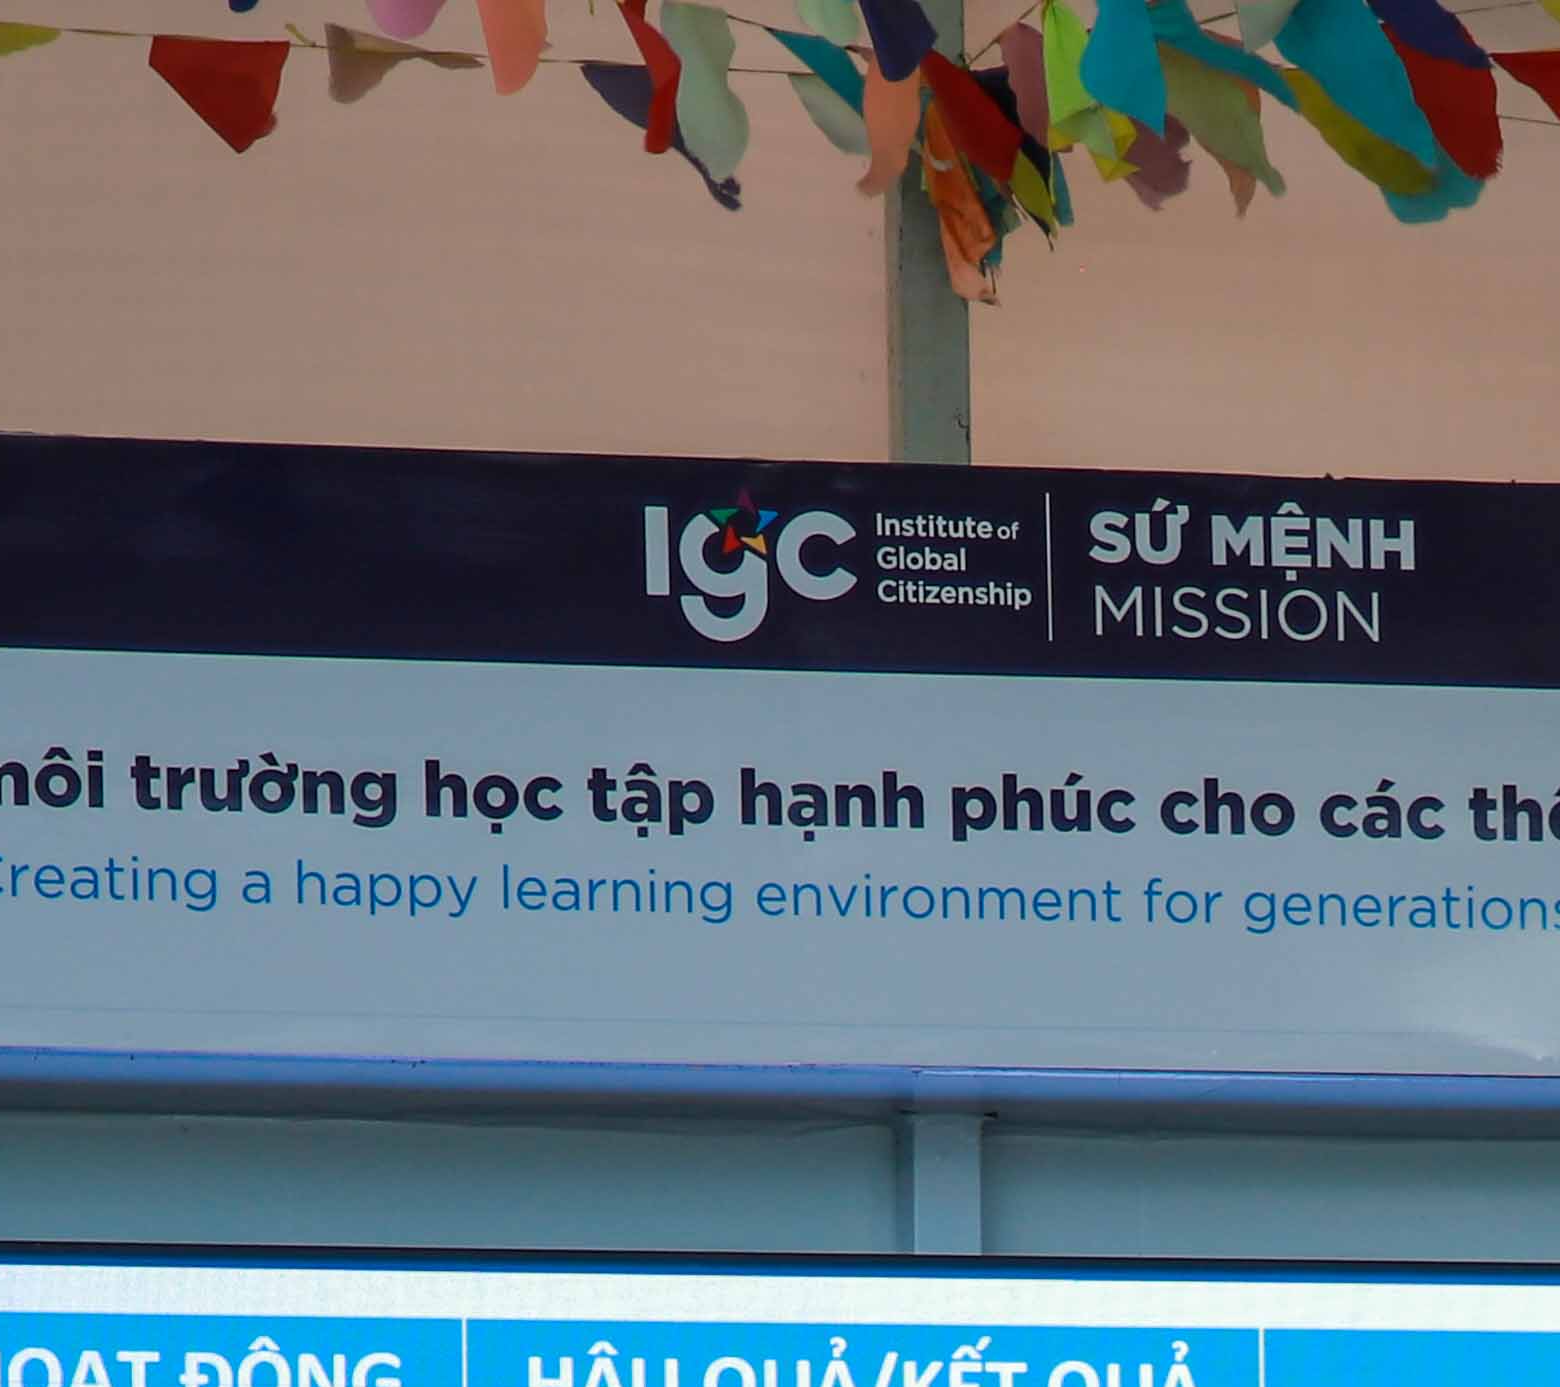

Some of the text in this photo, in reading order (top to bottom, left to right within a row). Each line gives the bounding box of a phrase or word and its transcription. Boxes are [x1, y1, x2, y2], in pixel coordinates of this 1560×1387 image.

[874, 510, 1021, 542] Institute of
[1086, 495, 1418, 583] SỨ MỆNH
[874, 543, 969, 574] Global
[875, 577, 1034, 613] Citizenship
[1092, 583, 1382, 645] MISSION
[128, 750, 400, 831] trường
[422, 757, 566, 838] học
[585, 760, 717, 841] tập
[738, 765, 927, 845] hạnh
[949, 770, 1138, 845] phúc
[1158, 775, 1298, 839] cho
[1317, 776, 1448, 843] các
[239, 868, 275, 907] a
[294, 856, 480, 921] happy
[500, 861, 735, 927] learning
[754, 871, 1125, 926] environment
[1141, 875, 1226, 927] for
